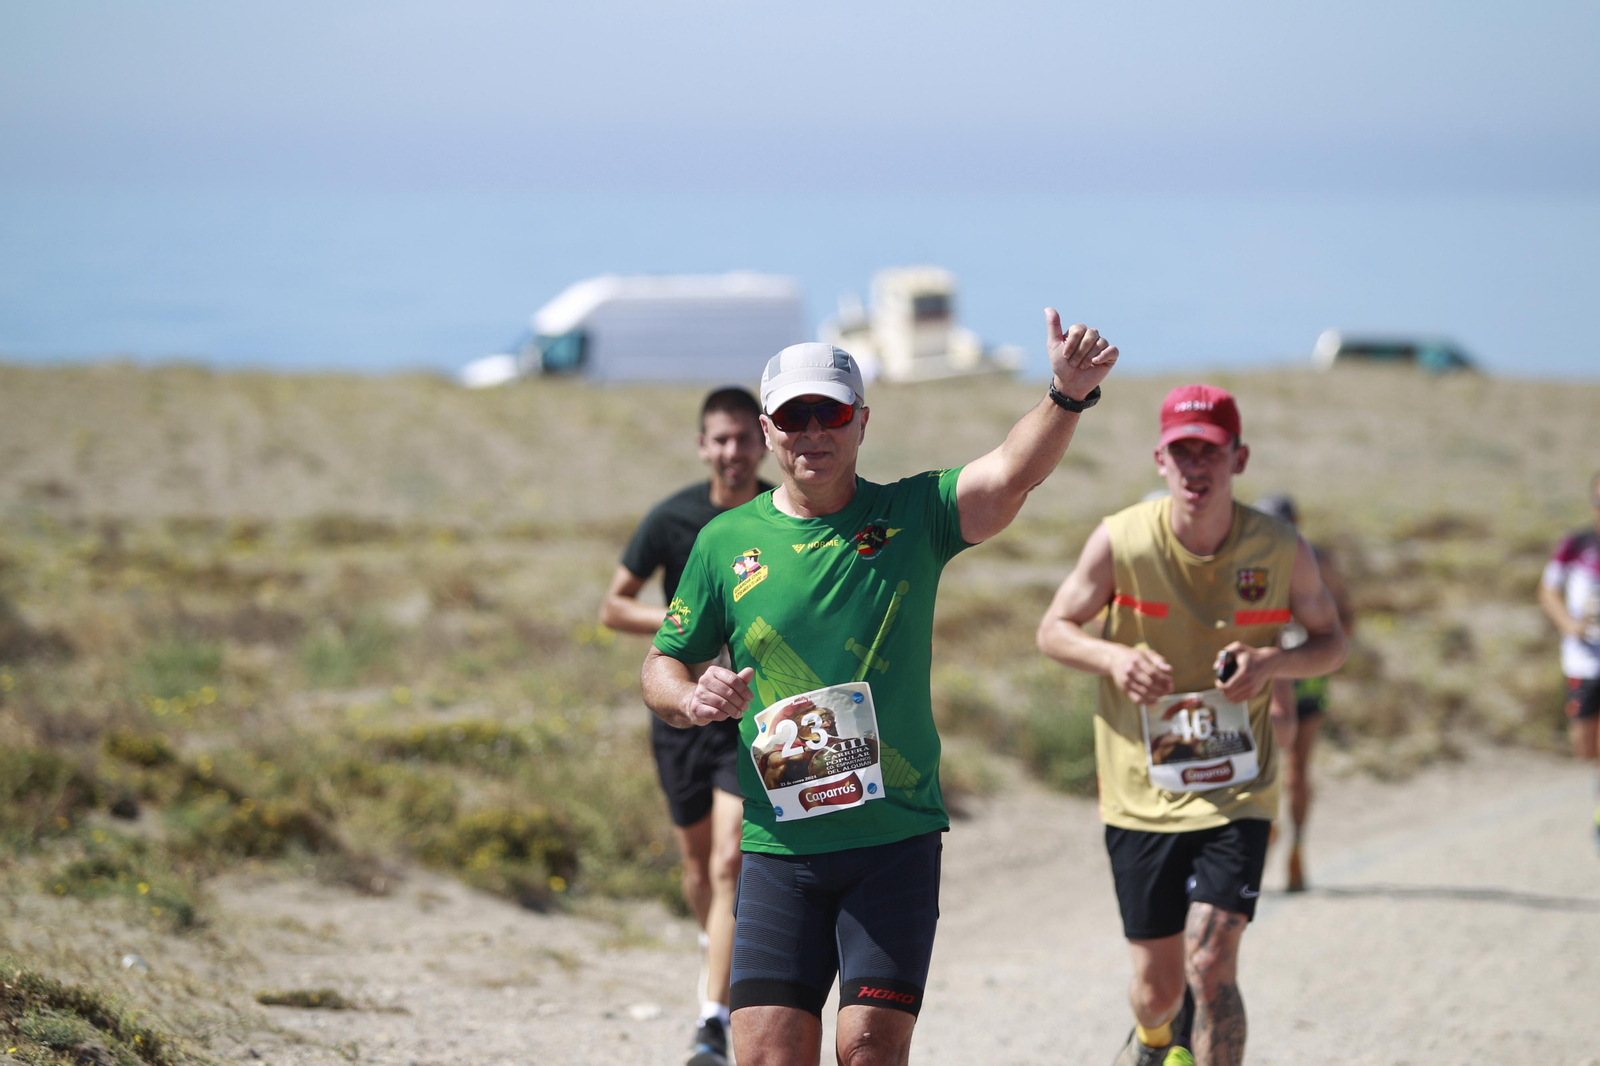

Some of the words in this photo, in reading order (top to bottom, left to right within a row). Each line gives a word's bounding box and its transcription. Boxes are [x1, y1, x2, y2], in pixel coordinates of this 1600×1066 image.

[1171, 708, 1213, 742] 46
[776, 713, 828, 757] 23
[823, 737, 868, 756] XIII
[824, 746, 870, 761] CARRERA
[825, 751, 870, 766] POPULAR
[836, 755, 872, 768] ESPARTANOS
[857, 986, 916, 1004] HOKO
